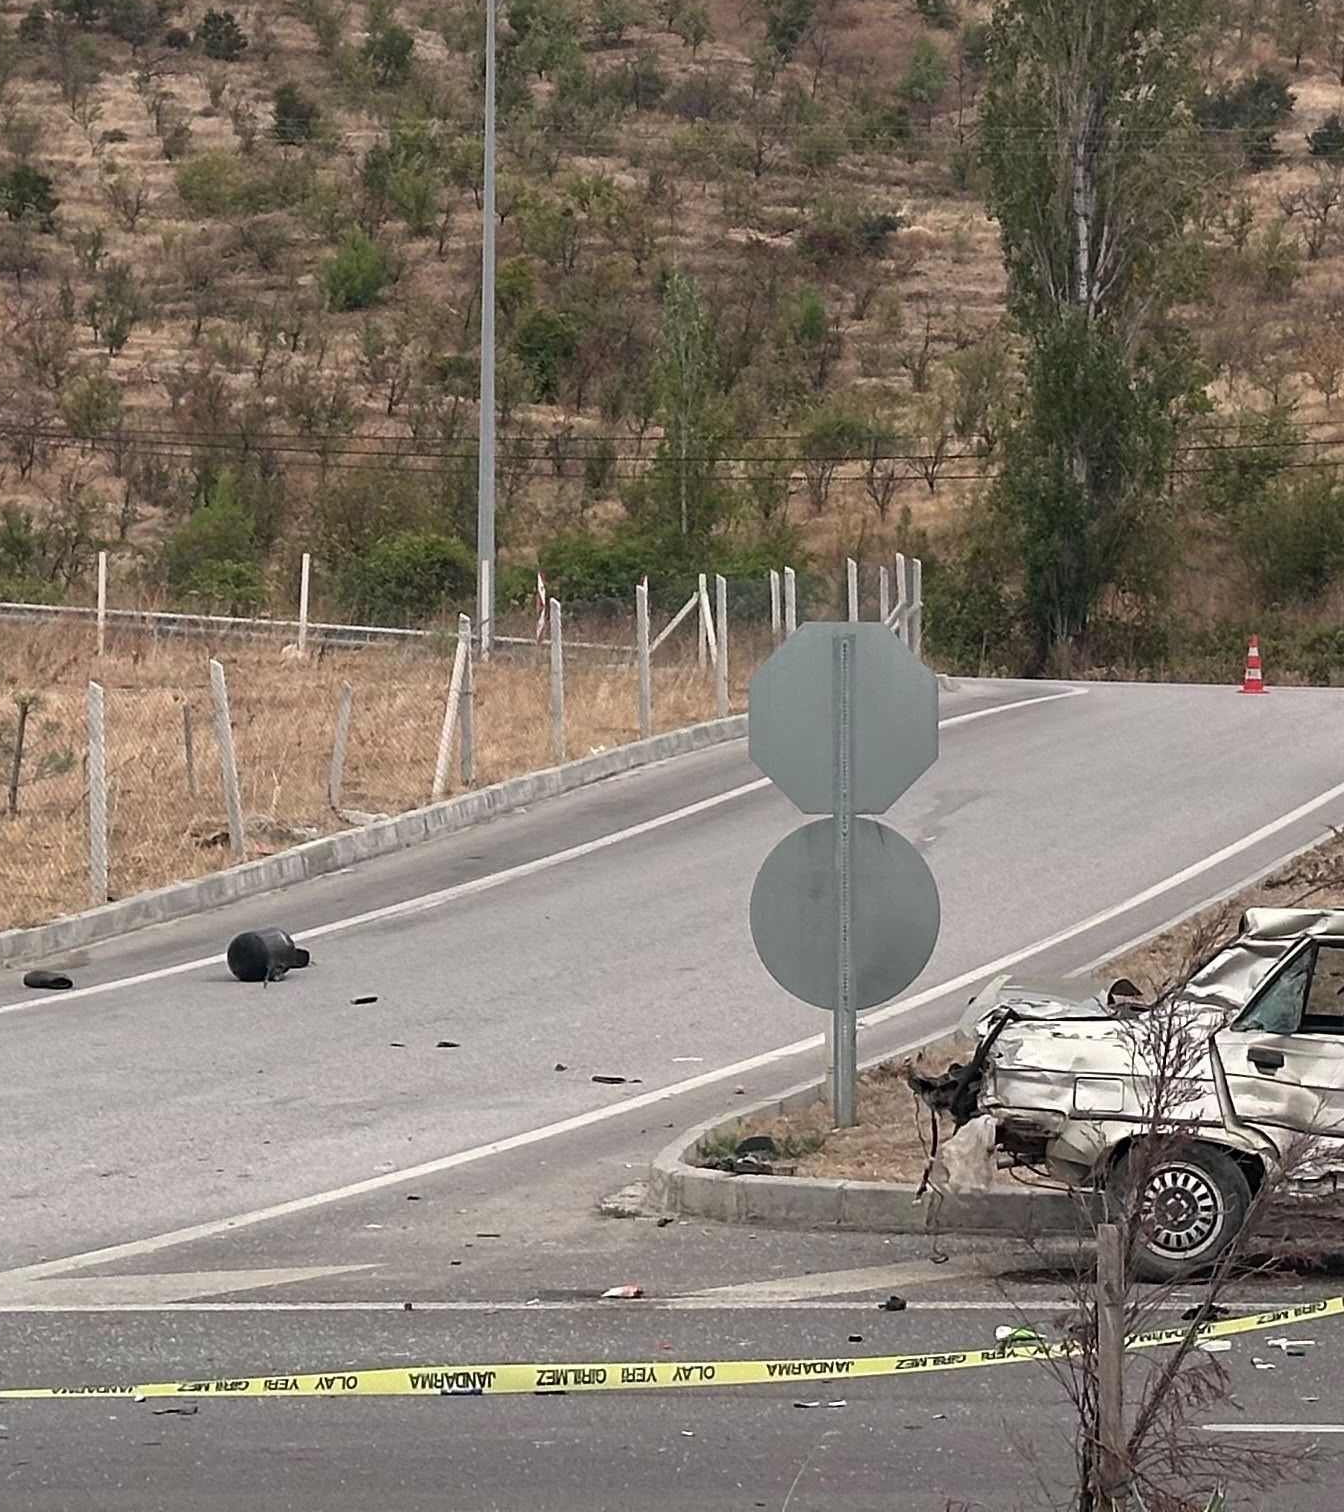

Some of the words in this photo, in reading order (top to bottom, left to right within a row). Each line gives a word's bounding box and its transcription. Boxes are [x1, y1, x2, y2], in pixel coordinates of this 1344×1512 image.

[672, 1364, 716, 1382] OLAY
[766, 1360, 855, 1378] JANDARMA
[314, 1375, 358, 1391] OLAY
[408, 1370, 497, 1389] JANDARMA
